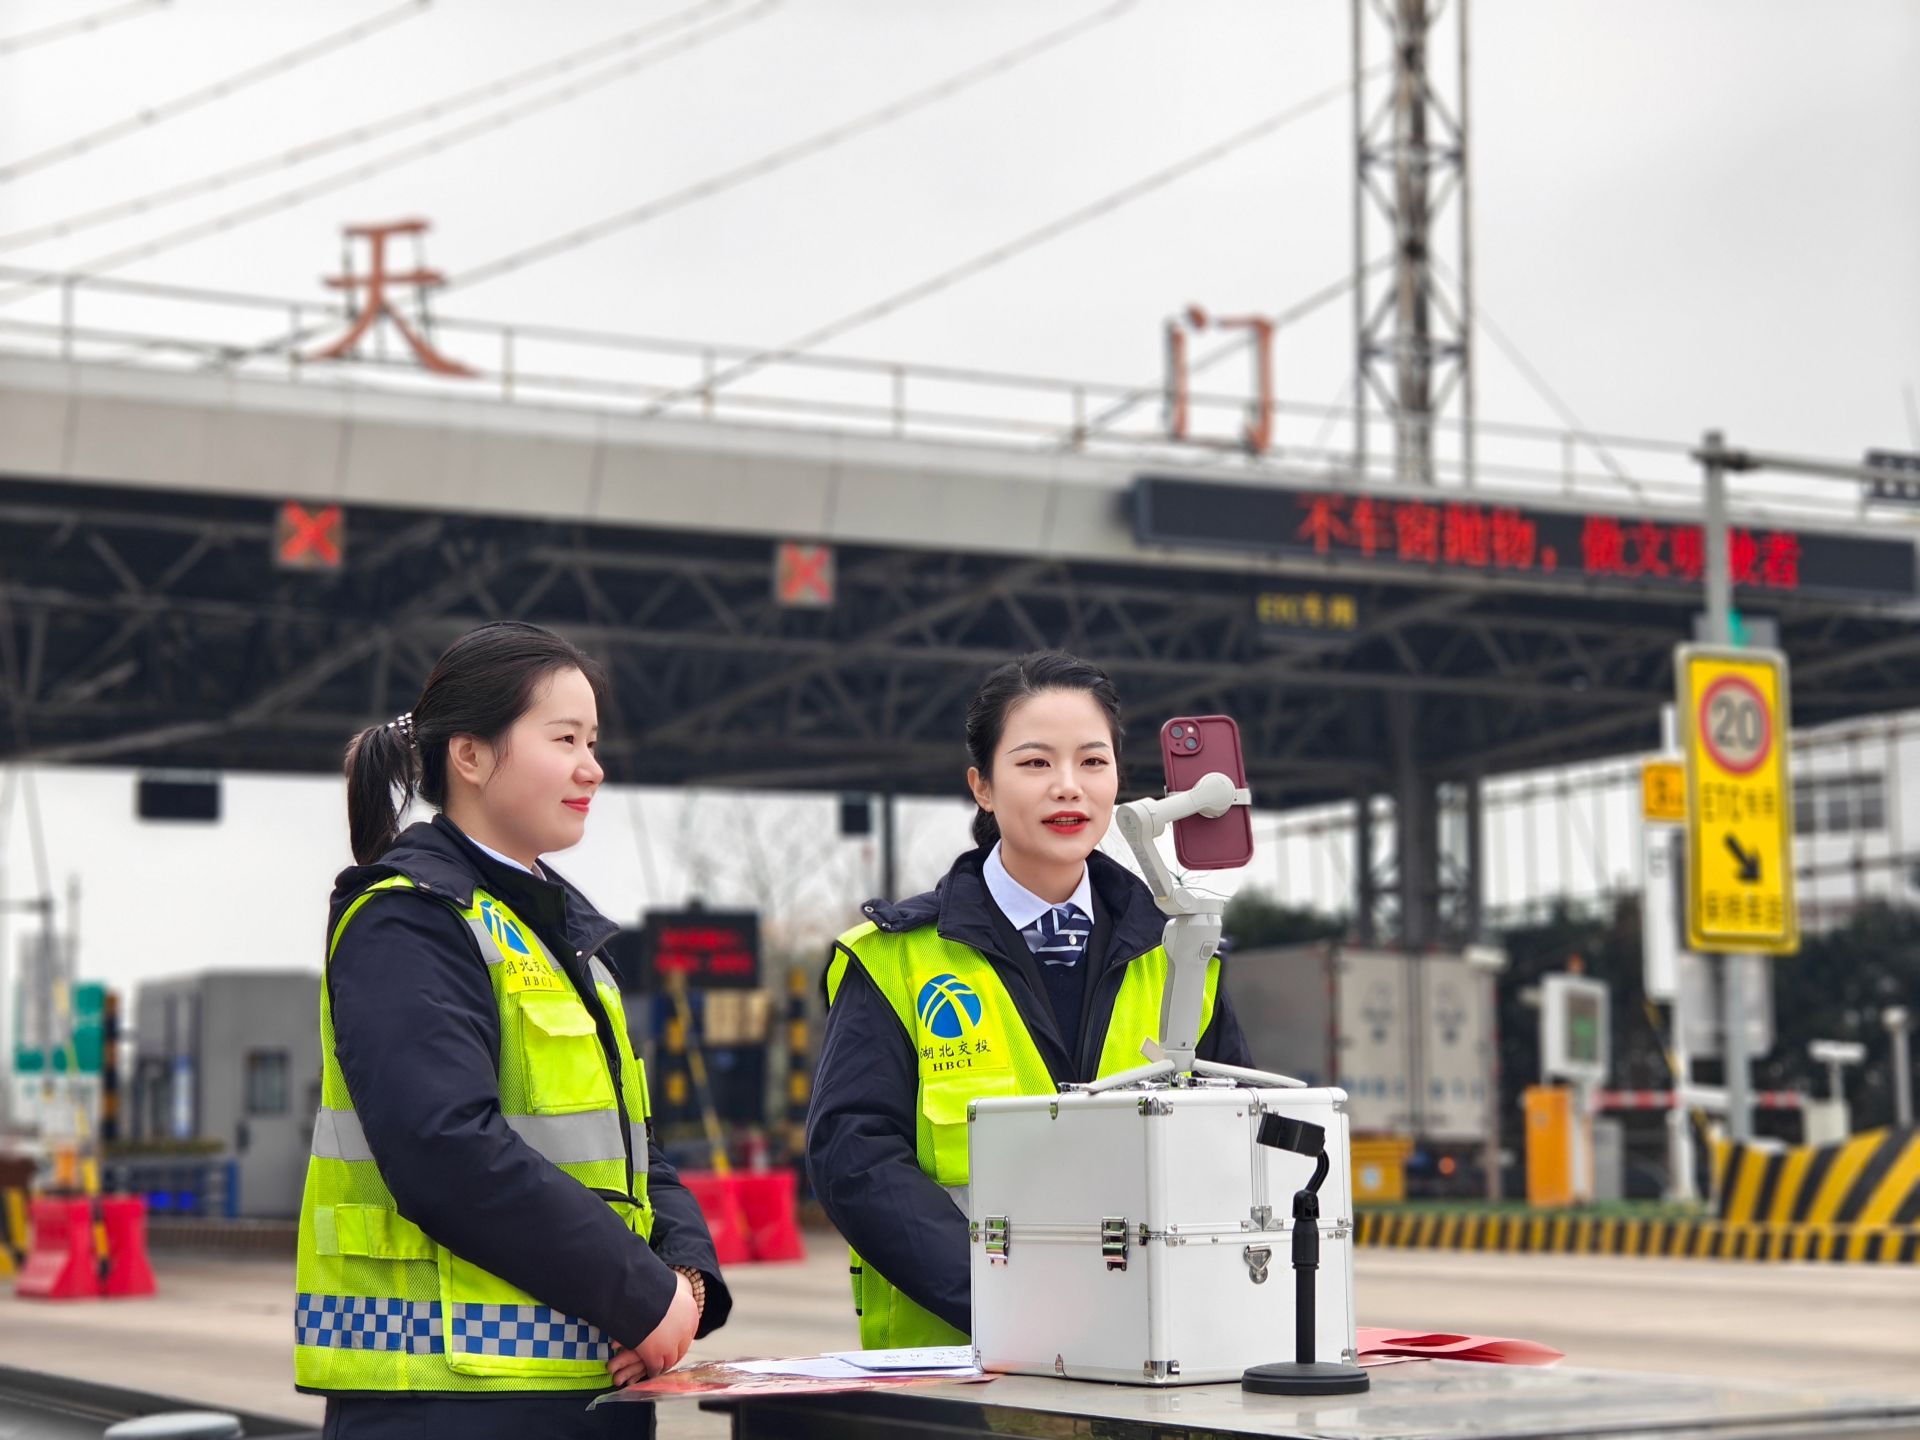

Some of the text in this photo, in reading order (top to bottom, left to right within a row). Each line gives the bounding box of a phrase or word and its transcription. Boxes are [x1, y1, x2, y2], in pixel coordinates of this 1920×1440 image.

[304, 219, 1275, 454] 天 门
[1711, 694, 1762, 750] 20
[522, 975, 553, 988] HBCI
[919, 1038, 992, 1060] 湖北交投
[932, 1058, 973, 1072] HBCI
